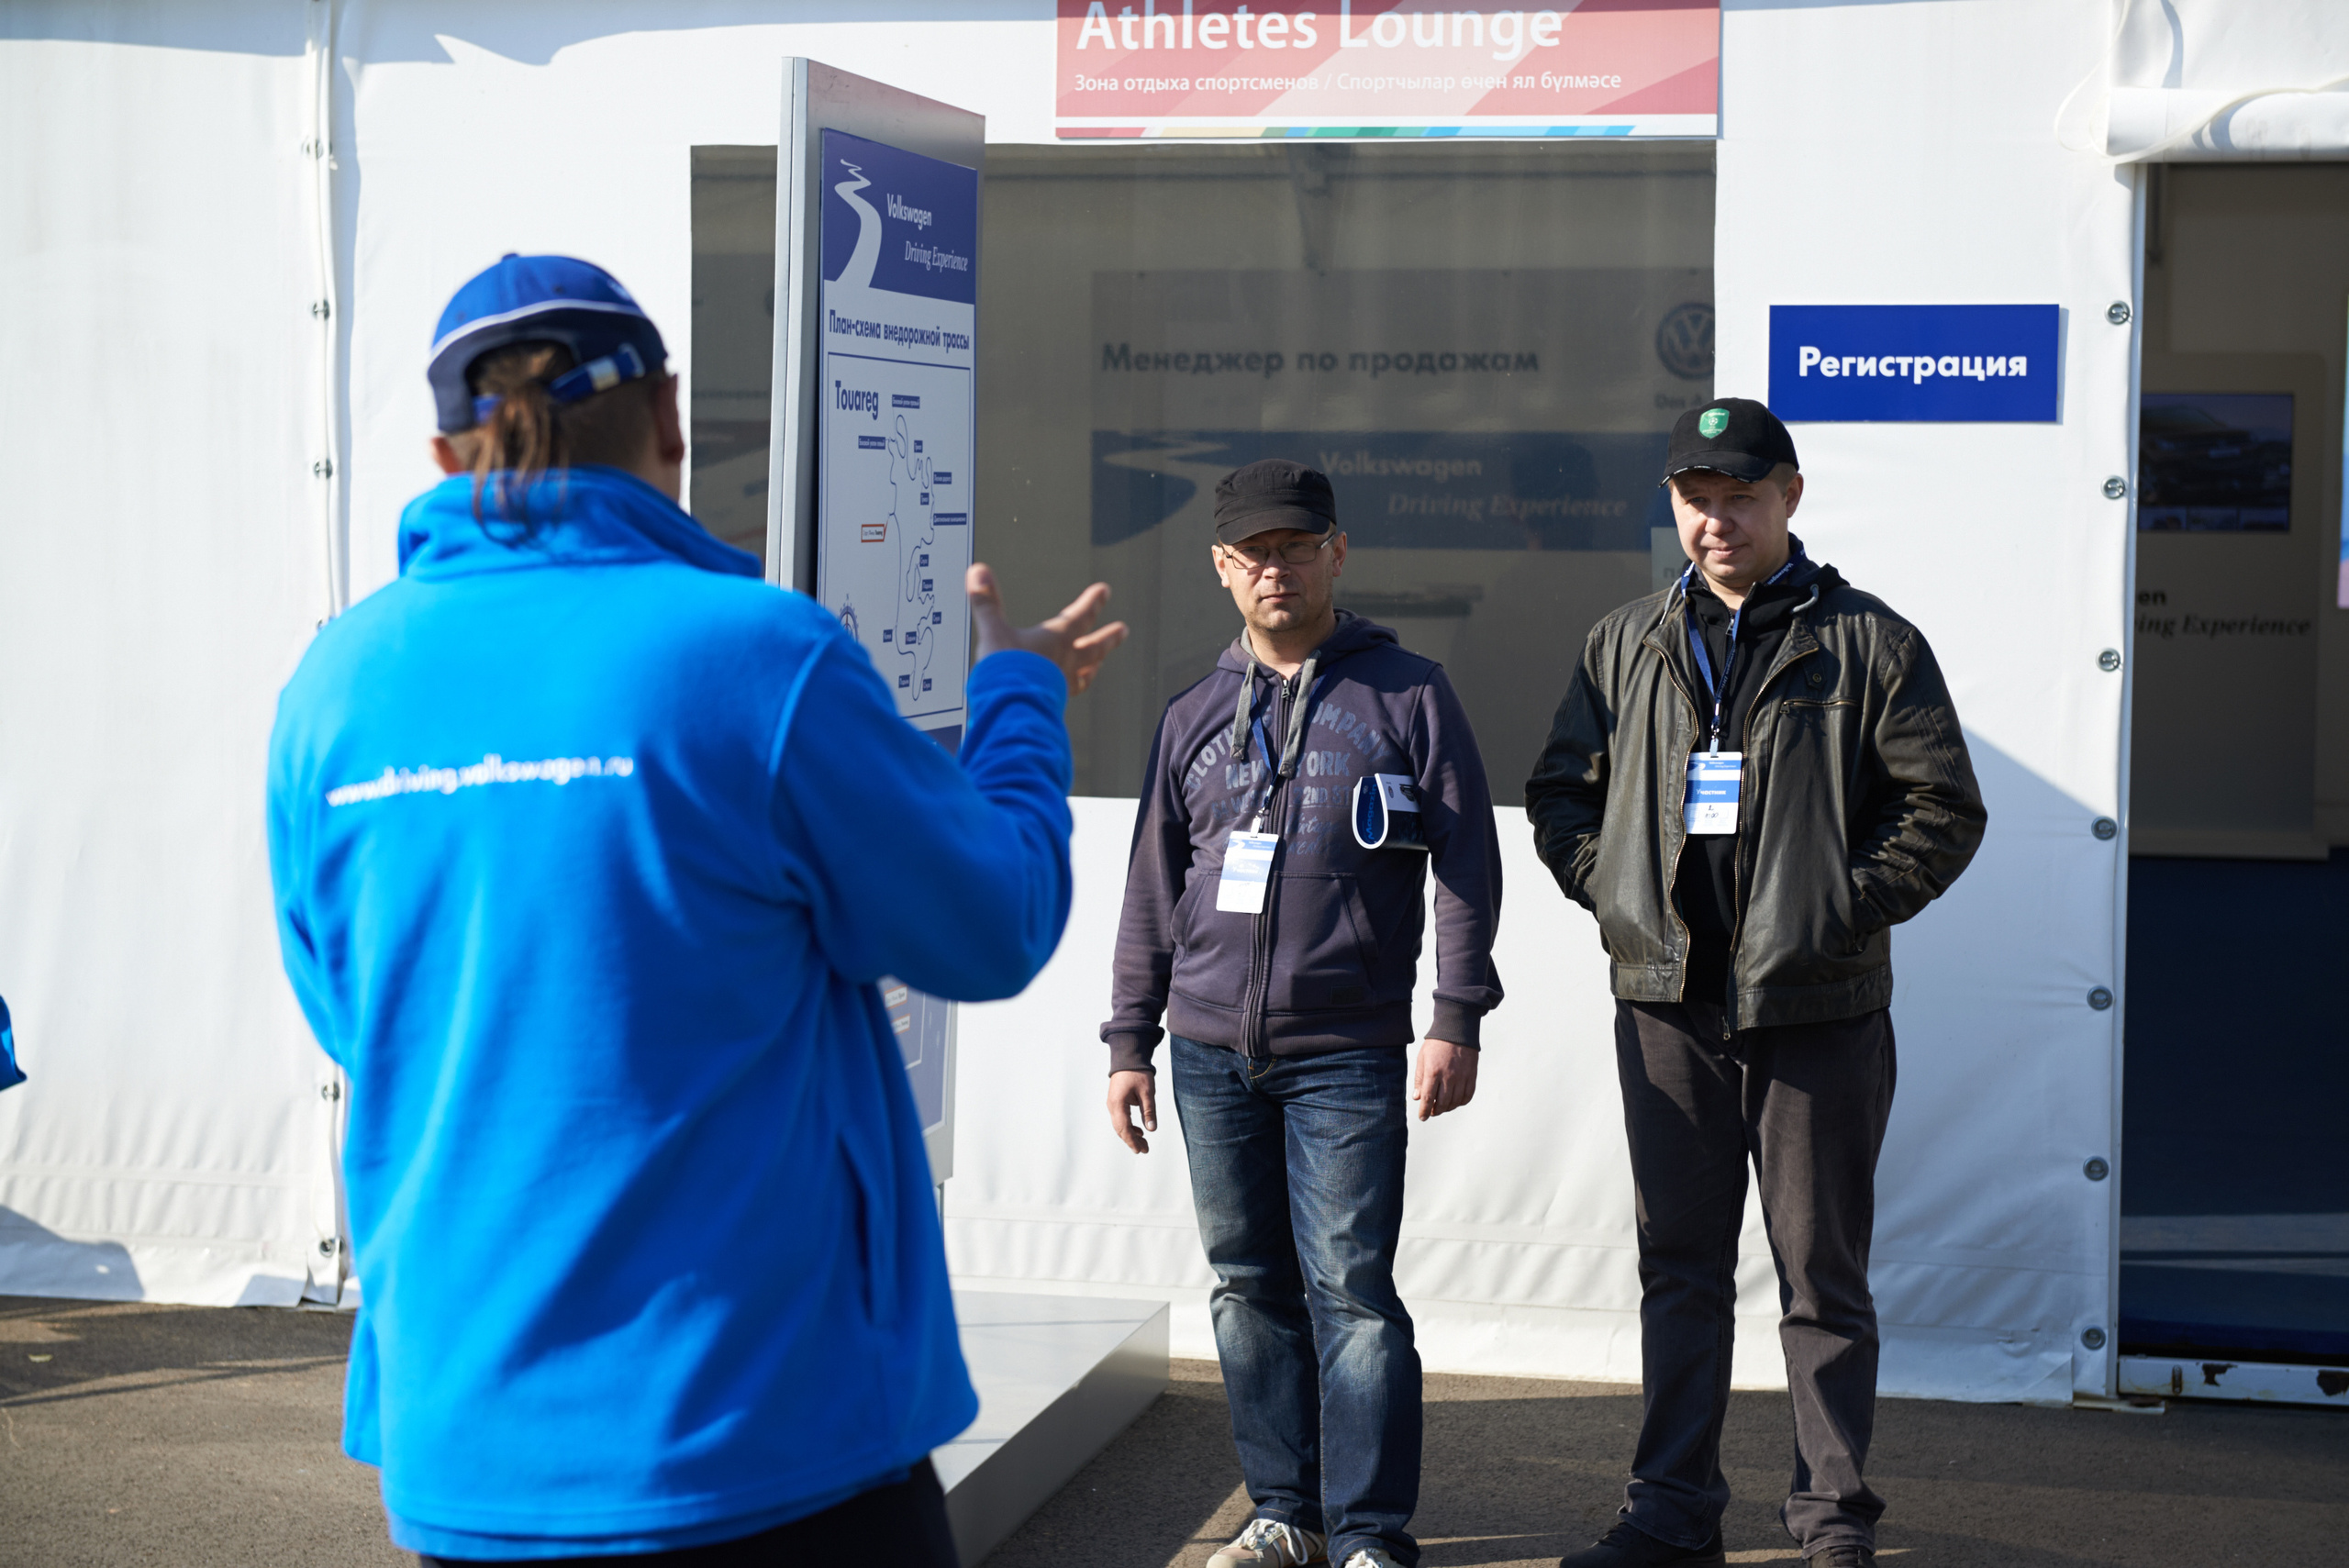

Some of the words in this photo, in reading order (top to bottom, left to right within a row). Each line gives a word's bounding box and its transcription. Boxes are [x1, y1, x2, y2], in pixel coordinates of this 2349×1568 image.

[1076, 0, 1318, 50] Athletes
[1340, 0, 1563, 61] Lounge
[1074, 74, 1119, 91] Зона
[1123, 77, 1190, 94] отдыха
[1195, 77, 1319, 95] спортсменов
[1337, 72, 1456, 94] Спортчылар
[1461, 75, 1508, 89] өчен
[1512, 75, 1535, 89] ял
[1541, 71, 1622, 93] бүлмәсе
[886, 193, 932, 230] Volkswagen
[905, 240, 932, 272] Driving
[932, 246, 969, 273] Experience
[829, 309, 881, 339] План-схема
[884, 324, 941, 350] внедорожной
[942, 333, 970, 354] трассы
[1102, 342, 1284, 380] Менеджер
[1297, 351, 1338, 372] по
[1349, 351, 1539, 380] продажам
[1798, 346, 2028, 384] Регистрация
[835, 380, 879, 421] Touareg
[1319, 450, 1483, 484] Volkswagen
[1388, 493, 1483, 522] Driving
[1490, 493, 1627, 521] Experience
[2182, 614, 2312, 640] Experience
[1365, 784, 1377, 840] Magazin
